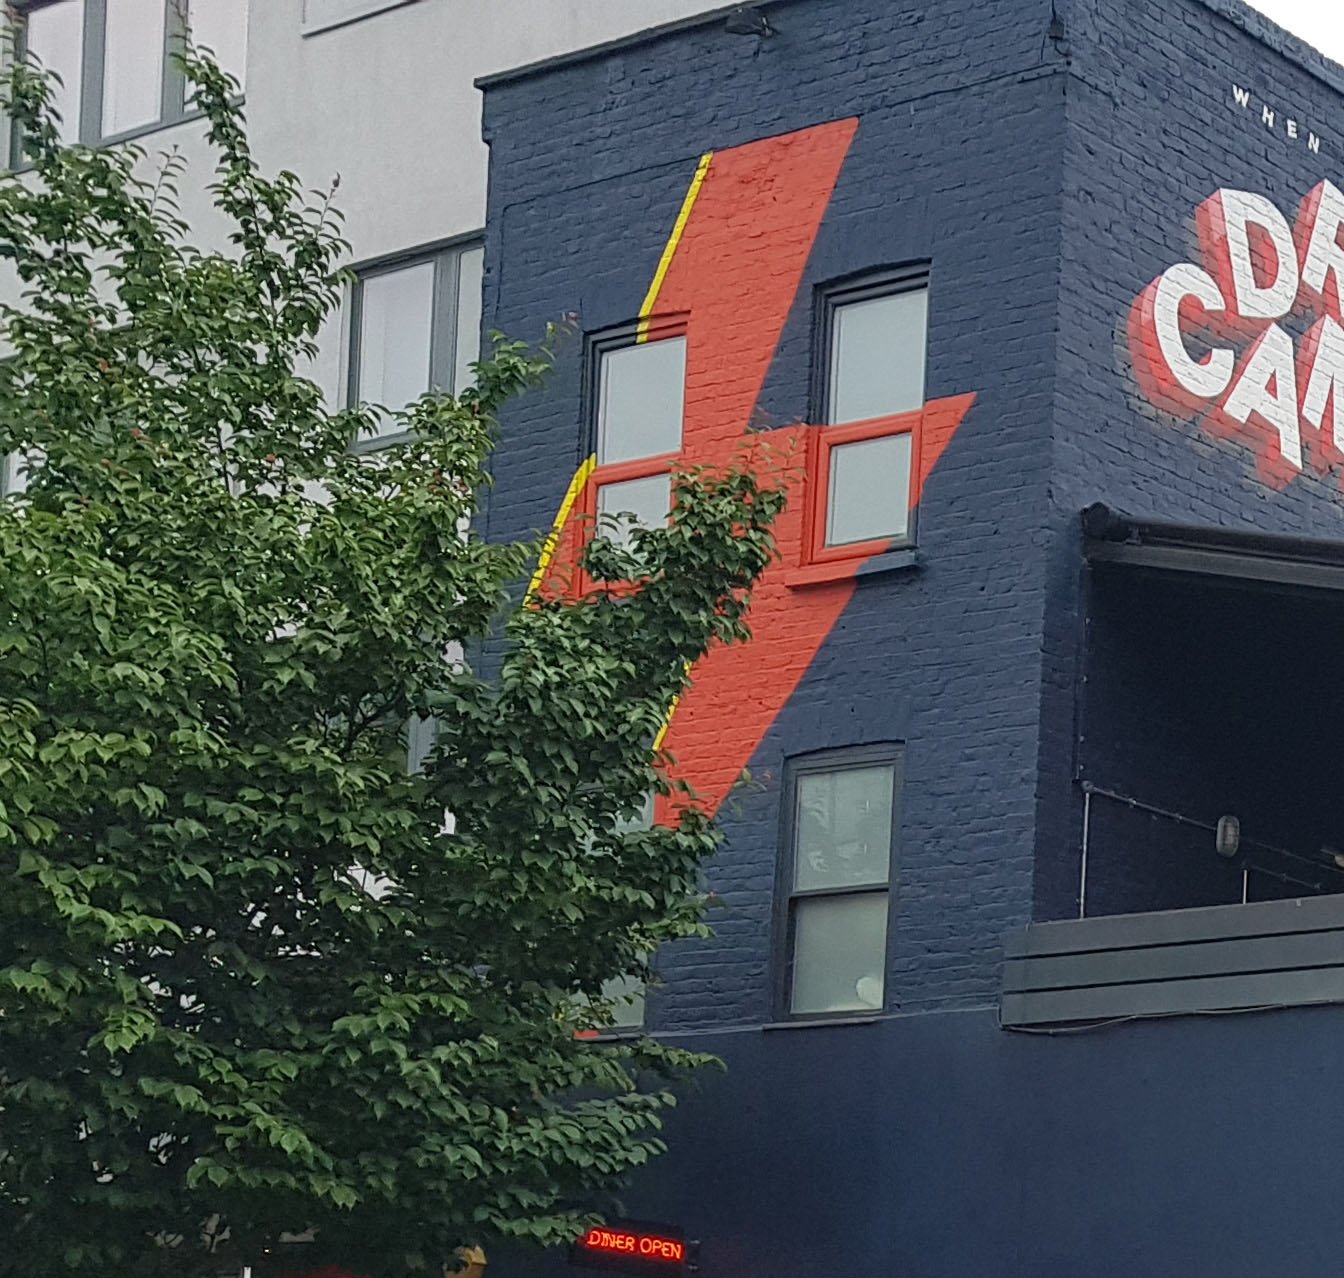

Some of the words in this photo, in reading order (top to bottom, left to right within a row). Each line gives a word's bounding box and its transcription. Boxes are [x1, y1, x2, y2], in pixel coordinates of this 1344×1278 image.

[1232, 84, 1320, 153] WHEN
[587, 1230, 636, 1252] DINER
[640, 1237, 682, 1259] OPEN
